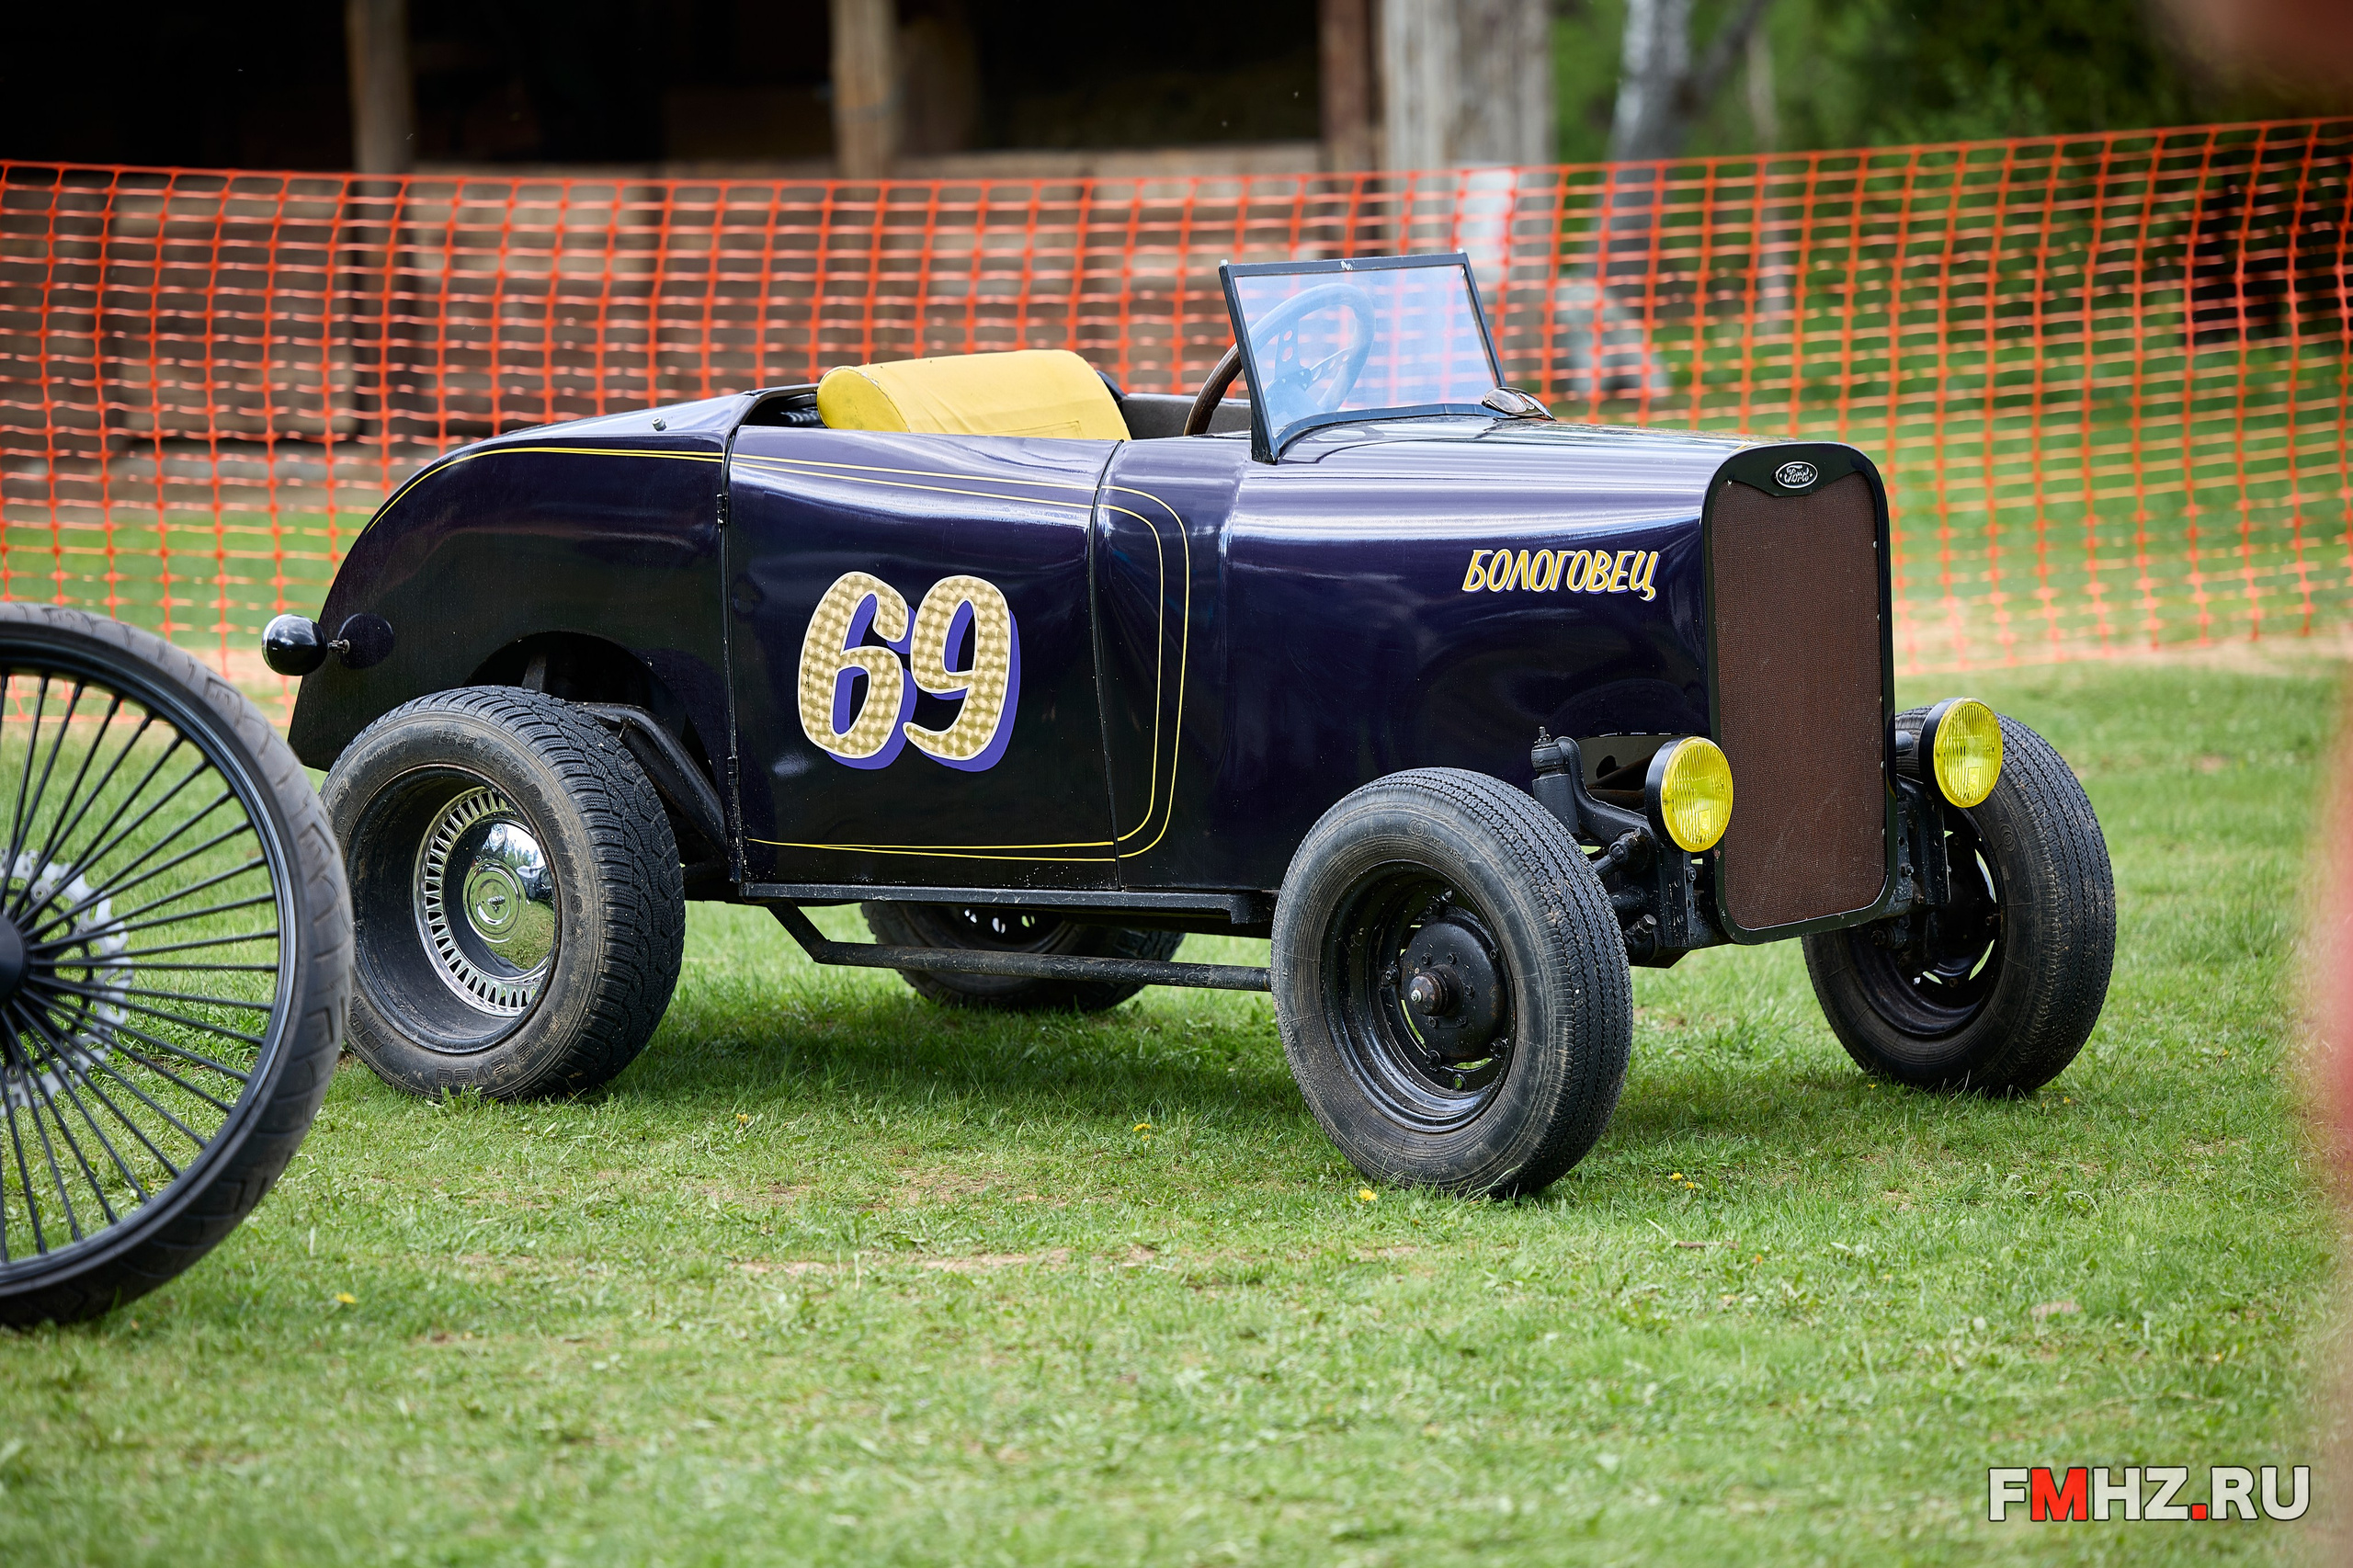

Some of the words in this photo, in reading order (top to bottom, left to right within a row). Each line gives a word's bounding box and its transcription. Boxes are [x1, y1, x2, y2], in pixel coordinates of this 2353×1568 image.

[1784, 464, 1810, 483] Ford
[1461, 549, 1660, 601] БОЛОГОВЕЦ
[798, 572, 1019, 771] 69
